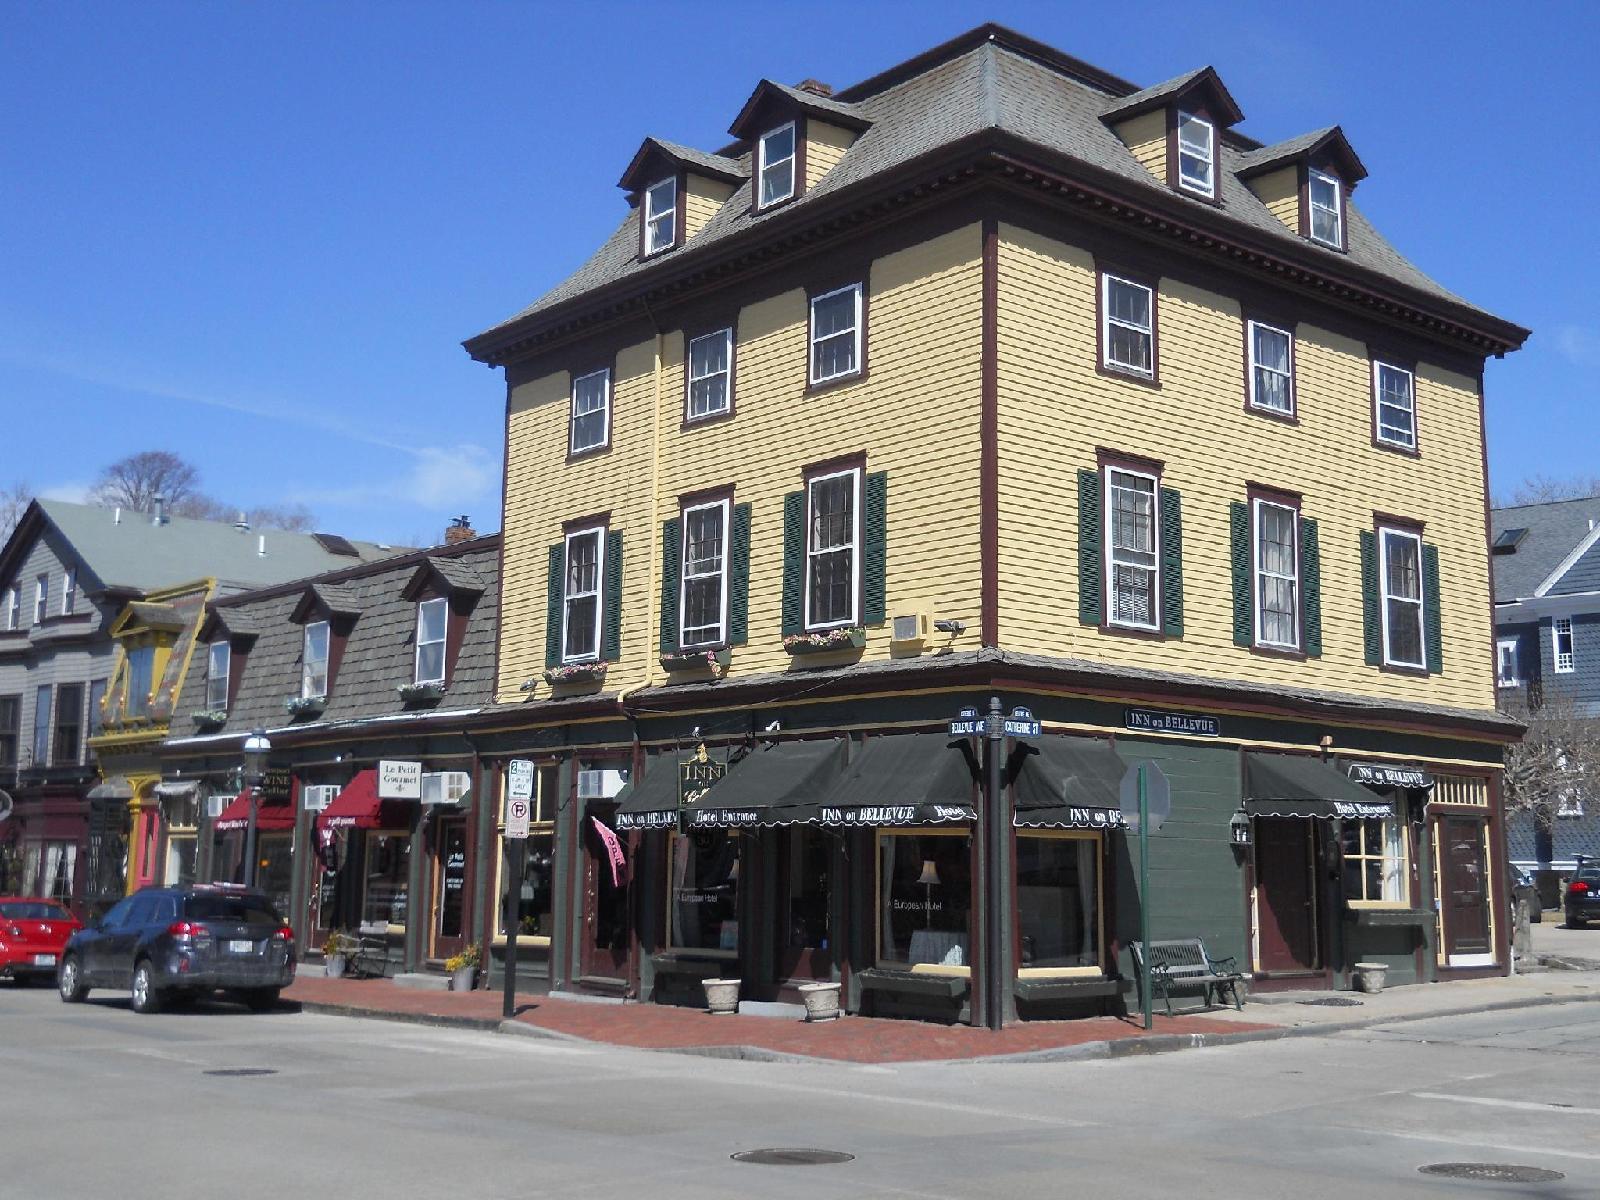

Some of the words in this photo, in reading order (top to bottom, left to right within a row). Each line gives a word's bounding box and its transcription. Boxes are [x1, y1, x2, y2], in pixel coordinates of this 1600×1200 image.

[1005, 721, 1030, 734] CATHERINE
[1131, 713, 1150, 726] INN
[1152, 719, 1164, 727] on
[1165, 716, 1214, 732] BELLEVUE
[386, 765, 395, 773] Le
[398, 765, 416, 773] Petit
[685, 765, 722, 780] INN
[384, 775, 416, 784] Gourmet
[616, 813, 634, 825] INN
[696, 809, 718, 822] Hotel
[722, 808, 758, 821] Entrance
[823, 808, 842, 820] INN
[846, 811, 856, 821] on
[859, 806, 915, 821] BELLEVUE
[1070, 808, 1090, 821] INN
[1094, 812, 1106, 822] on
